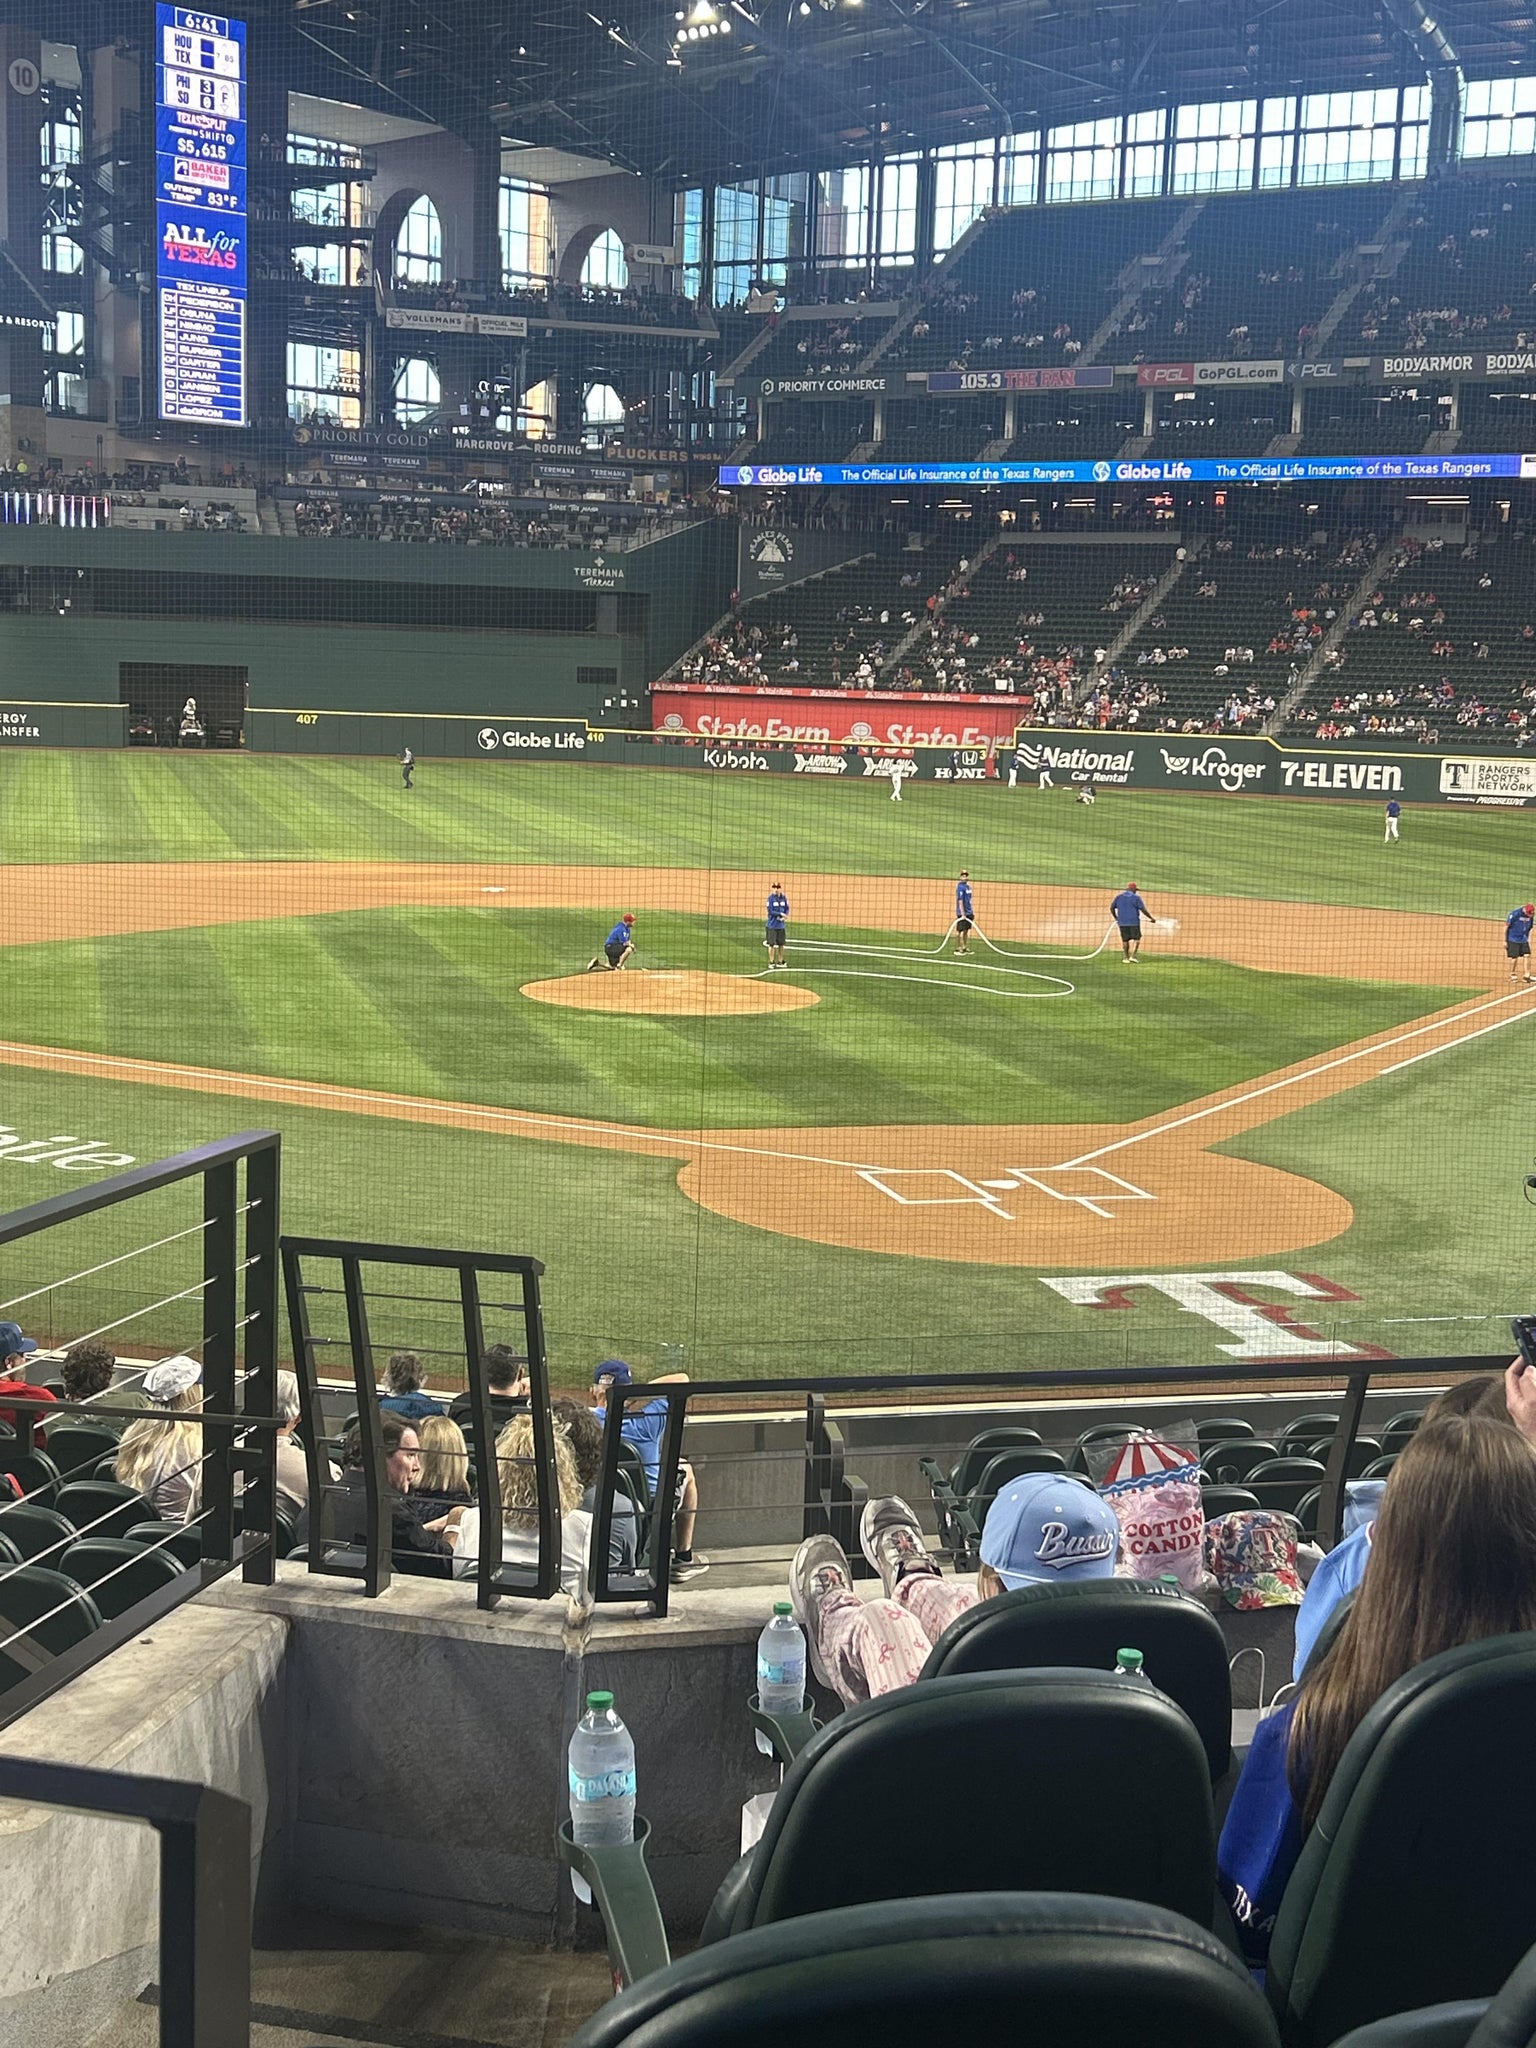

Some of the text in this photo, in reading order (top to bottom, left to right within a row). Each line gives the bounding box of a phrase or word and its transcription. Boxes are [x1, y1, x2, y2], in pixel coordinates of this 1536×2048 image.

[185, 14, 219, 34] 6:41
[174, 33, 192, 49] HOU
[174, 49, 191, 64] TEX
[14, 65, 33, 87] 10
[176, 73, 212, 94] PHI 3
[203, 95, 212, 109] 0
[222, 92, 228, 103] F
[177, 138, 226, 159] $5,615
[191, 162, 227, 176] BAKER
[170, 191, 196, 202] TEMP
[163, 222, 240, 258] ALL for
[164, 242, 237, 269] TEXAS
[176, 281, 230, 296] TEX LINEUP
[15, 317, 56, 330] RESORTS
[179, 321, 215, 333] NIMMO
[179, 333, 209, 344] JUNG
[179, 357, 221, 370] CARTER
[1383, 356, 1473, 372] BODYARMOR
[1486, 354, 1536, 370] BODYA
[179, 369, 217, 381] DURAN
[1154, 369, 1189, 382] PGL
[1199, 367, 1278, 380] GoPGL.com
[1301, 364, 1338, 378] PGL
[778, 379, 886, 392] PRIORITY COMMERCE
[960, 370, 1077, 389] 105.3 THE FAN
[179, 393, 213, 405] LOPEZ
[313, 429, 428, 447] PRIORITY GOLD
[455, 438, 582, 455] HARGROVE ROOFING
[606, 447, 688, 462] PLUCKERS
[758, 467, 823, 482] Globe Life
[841, 467, 1075, 482] The Official Life Insurance of the Texas Rangers
[1116, 462, 1192, 479] Globe Life
[1216, 461, 1491, 476] The Official Life Insurance of the Texas Rangers
[574, 567, 624, 578] TEREMANA
[582, 578, 615, 588] TERRACE
[296, 714, 319, 725] 407
[502, 731, 585, 749] Globe Life
[586, 732, 605, 743] 410
[704, 749, 764, 770] Kubota
[808, 754, 841, 767] ARROW
[1043, 747, 1132, 772] National
[1191, 747, 1266, 791] Kroger
[1445, 763, 1469, 789] T
[1478, 765, 1531, 775] RANGERS
[1071, 771, 1128, 783] Car Rental
[1478, 773, 1520, 783] SPORTS
[1477, 781, 1534, 792] NETWORK
[1126, 1512, 1202, 1538] COTTON
[1130, 1532, 1202, 1556] CANDY
[1249, 1527, 1280, 1559] T
